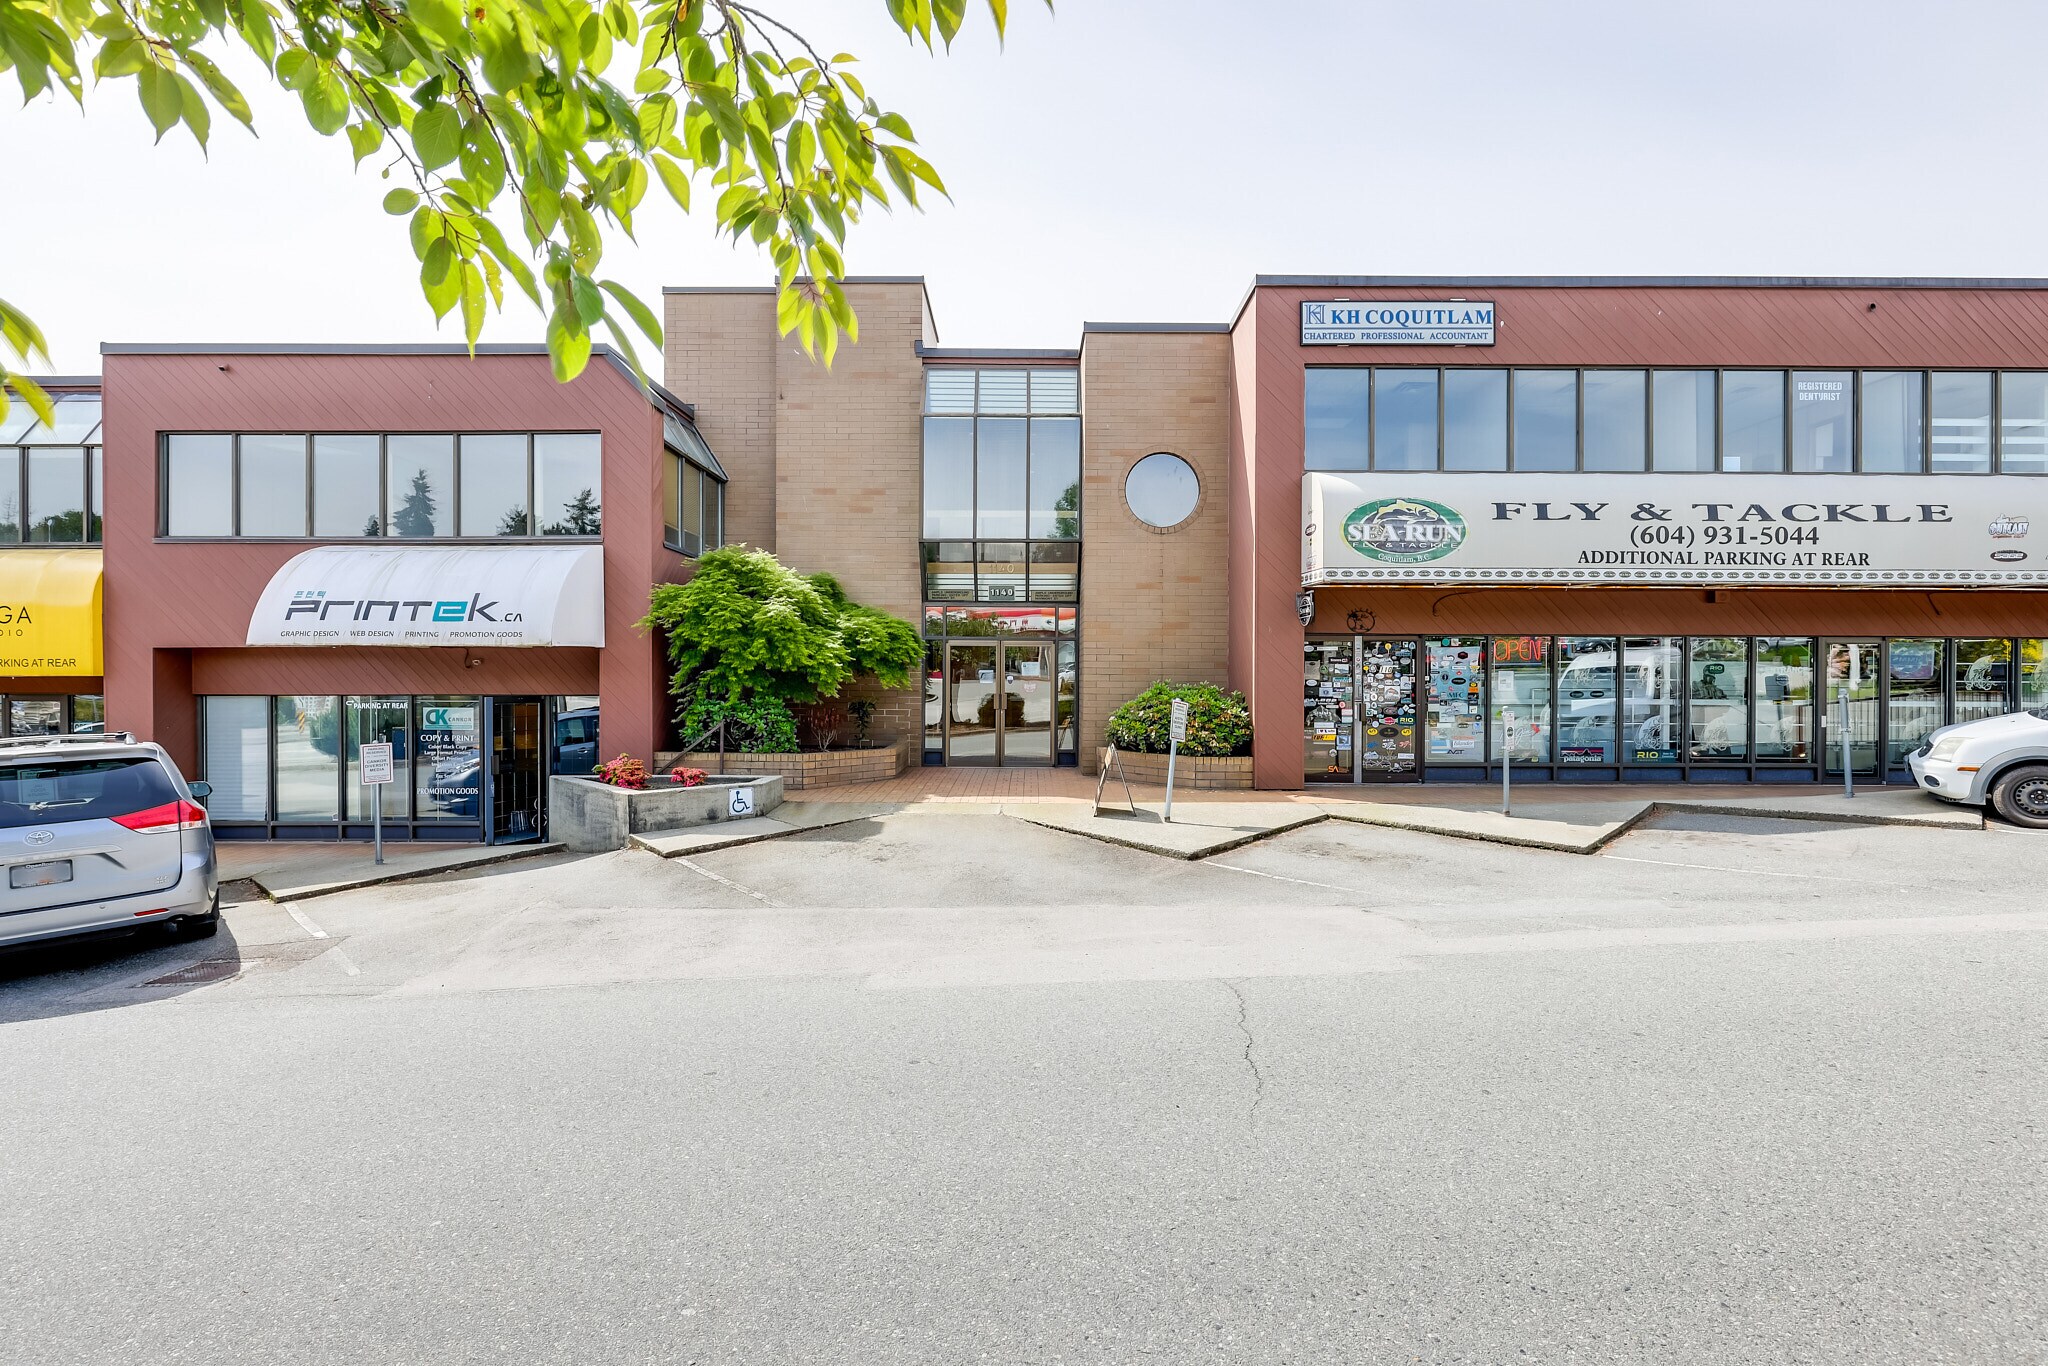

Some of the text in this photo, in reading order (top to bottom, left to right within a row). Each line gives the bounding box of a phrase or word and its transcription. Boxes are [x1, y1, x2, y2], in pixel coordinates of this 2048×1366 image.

[1331, 309, 1492, 327] KH COQUITLAM
[1304, 332, 1488, 340] CHARTERED PROFESSIONAL ACCOUNTANT
[1798, 382, 1842, 390] REGISTERED
[1800, 392, 1840, 400] DENTURIST
[1492, 502, 1953, 522] FLY & TACKLE
[1630, 525, 1820, 548] (604) 931-5044
[1578, 551, 1870, 566] ADDITIONAL PARKING AT REAR
[990, 588, 1013, 596] 1140
[1494, 640, 1542, 660] OPEN
[32, 658, 44, 667] AT
[47, 658, 76, 667] REAR
